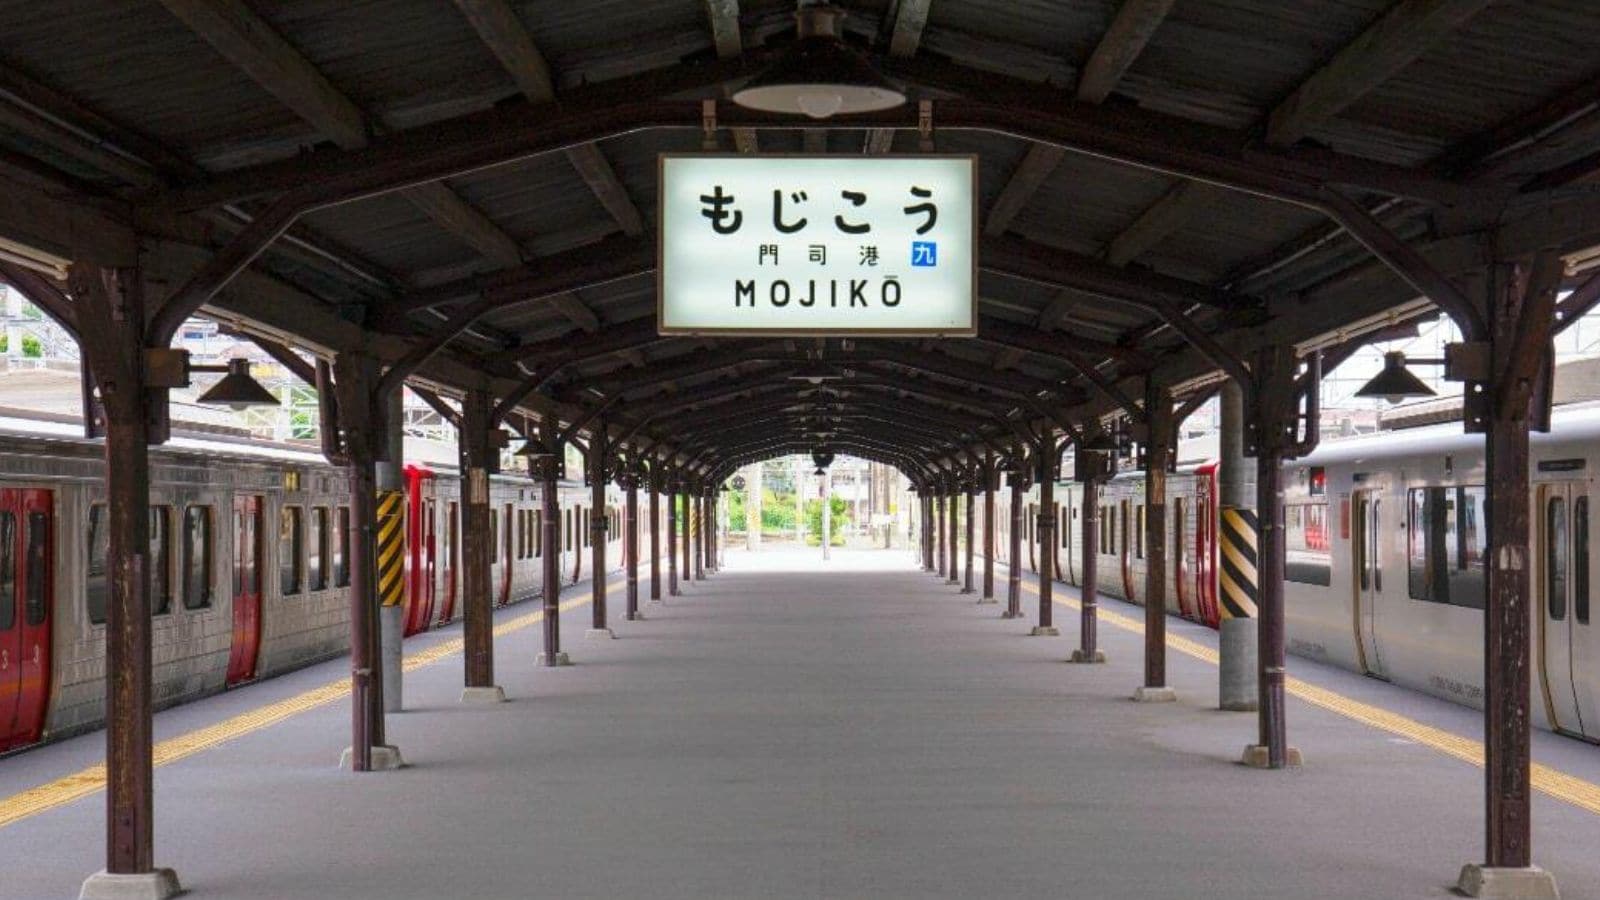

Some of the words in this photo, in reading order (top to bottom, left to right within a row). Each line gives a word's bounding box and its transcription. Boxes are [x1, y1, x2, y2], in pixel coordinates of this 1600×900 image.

[699, 185, 938, 235] もじこう
[758, 244, 880, 266] 門司港
[913, 243, 935, 265] 九
[734, 275, 902, 308] MOJIKŌ
